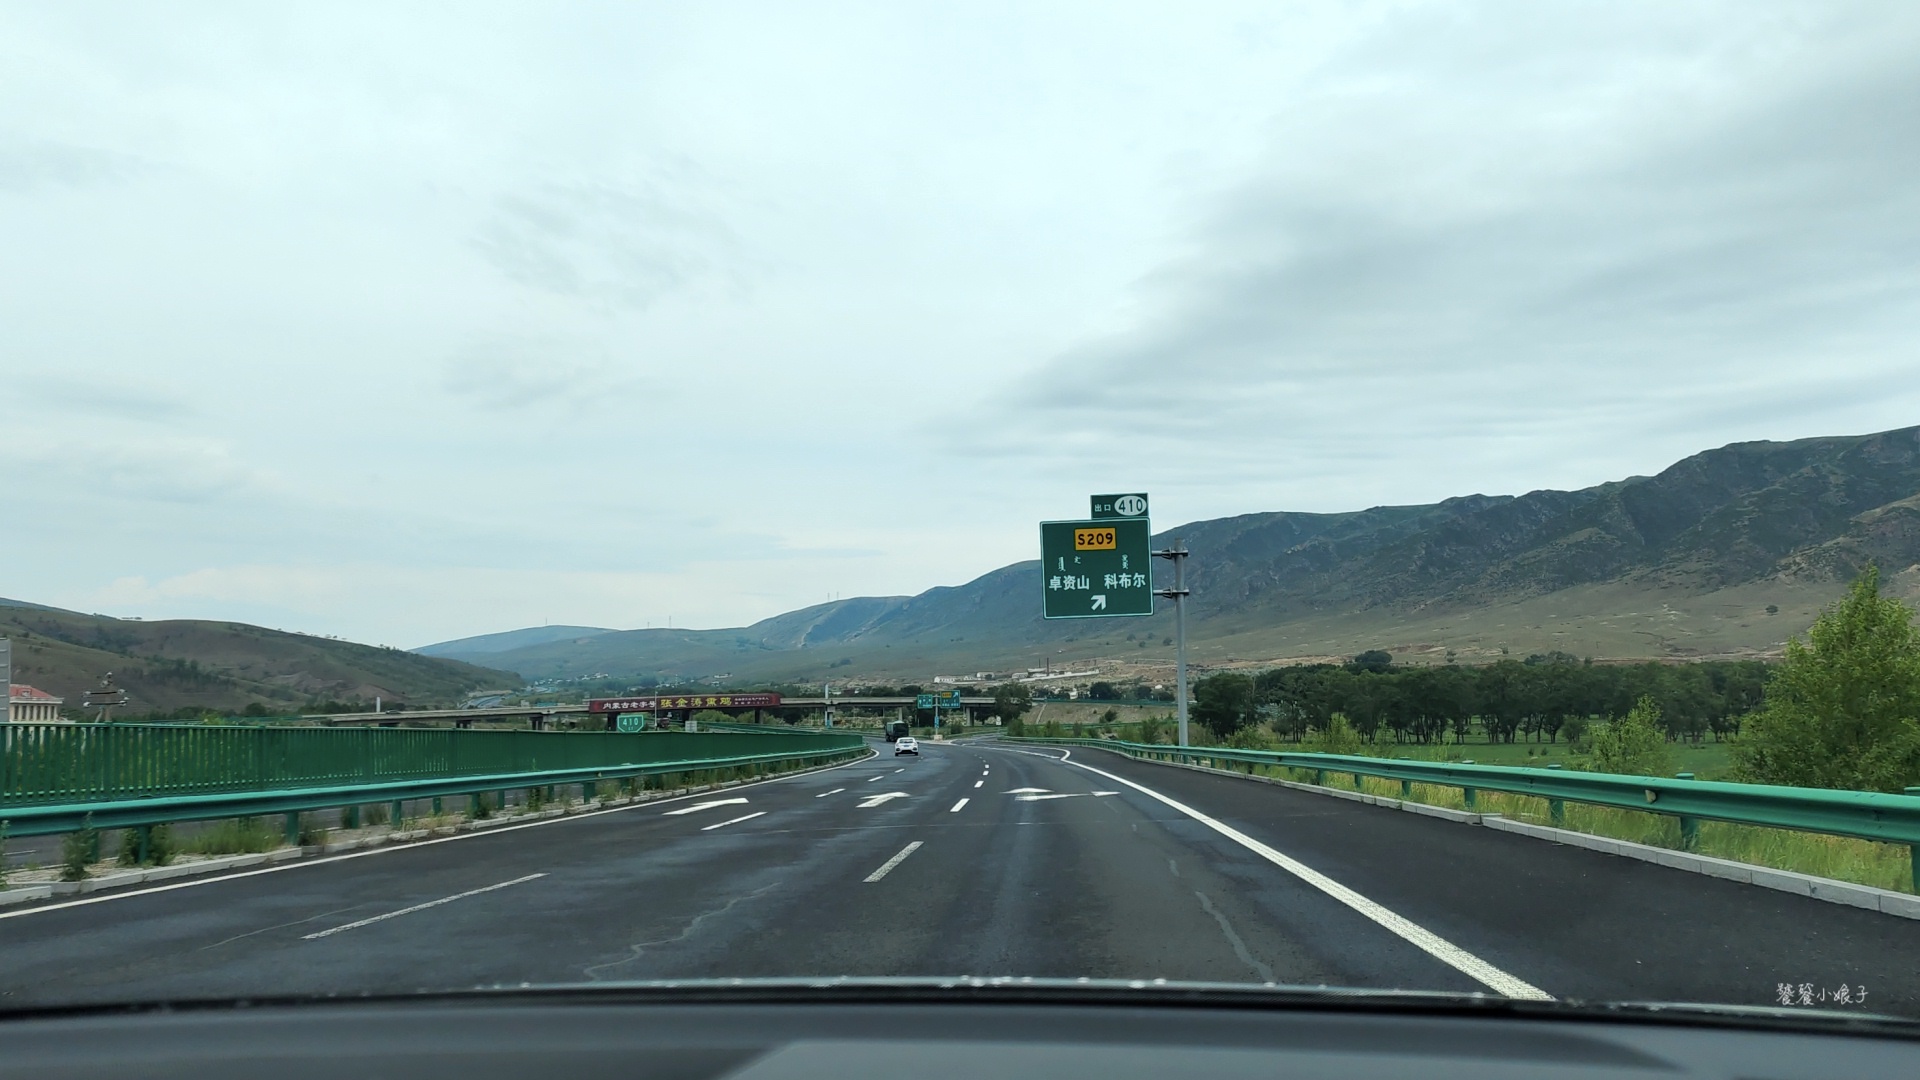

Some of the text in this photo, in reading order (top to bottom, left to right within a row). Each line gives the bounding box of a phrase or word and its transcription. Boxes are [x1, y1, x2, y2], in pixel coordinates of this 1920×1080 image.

[1094, 499, 1143, 513] 出口 410
[1077, 532, 1114, 545] S209
[1049, 572, 1146, 591] 卓资山 科布尔
[602, 700, 656, 710] 内蒙古老字号
[622, 717, 639, 726] 410
